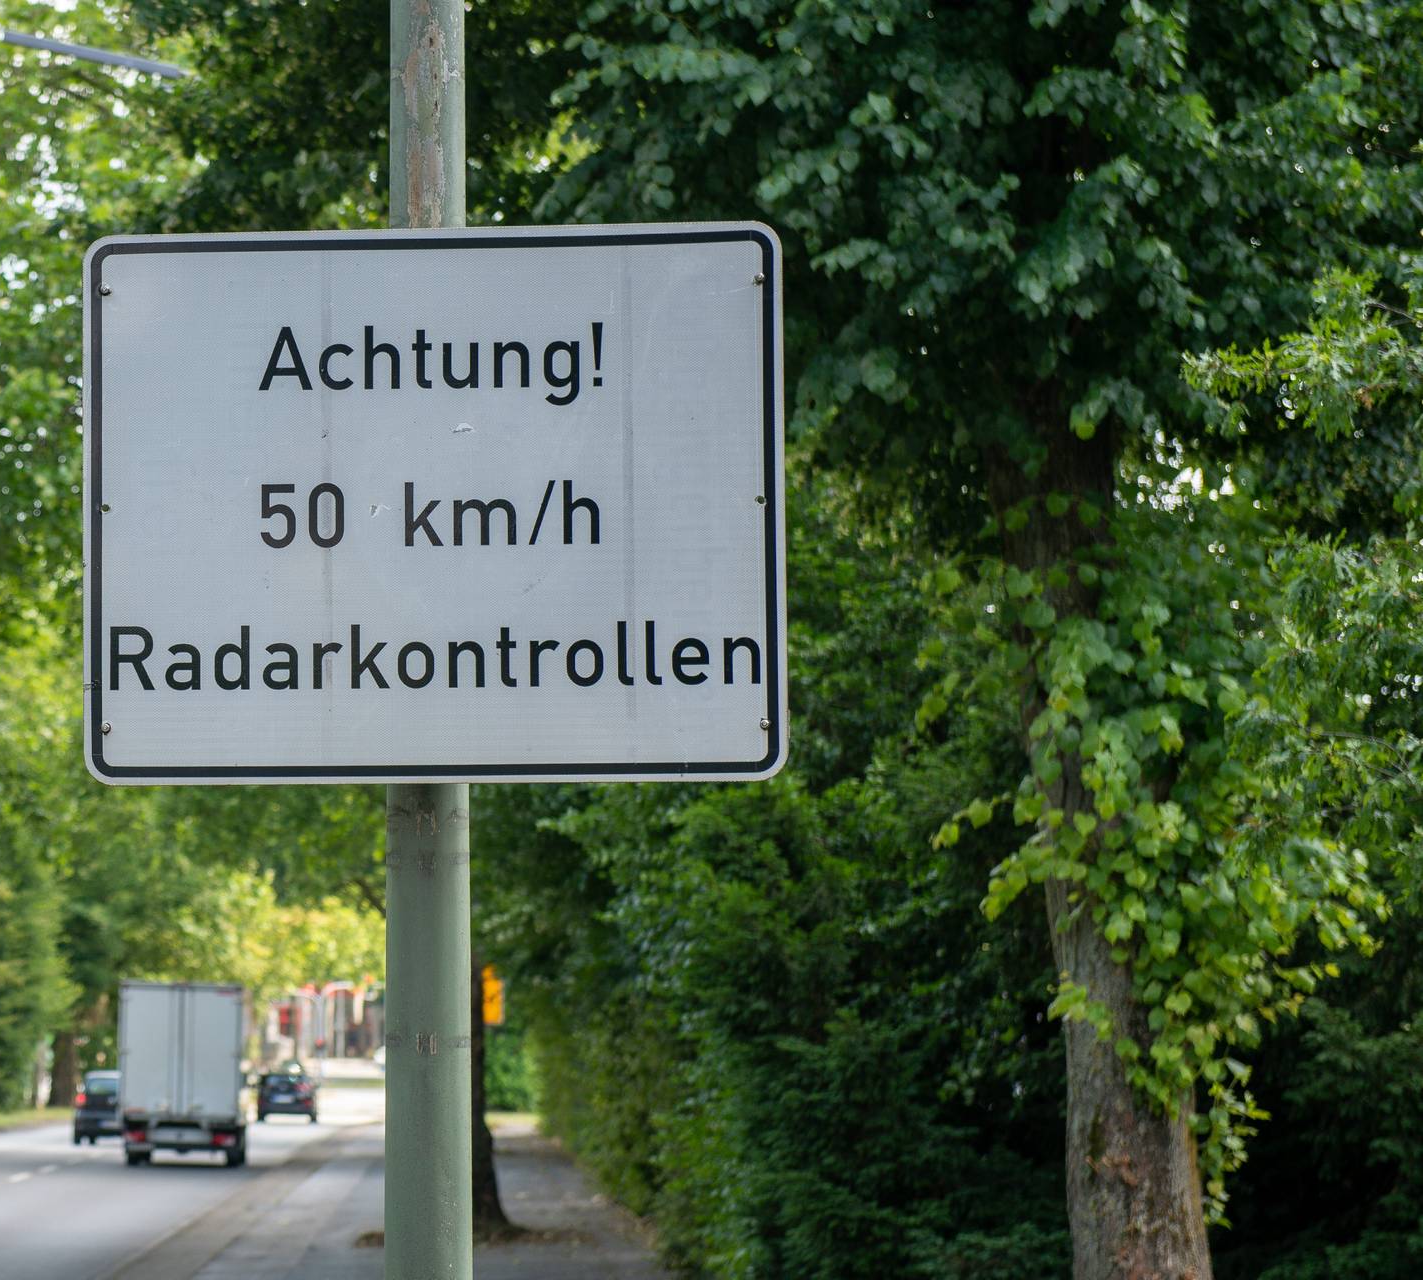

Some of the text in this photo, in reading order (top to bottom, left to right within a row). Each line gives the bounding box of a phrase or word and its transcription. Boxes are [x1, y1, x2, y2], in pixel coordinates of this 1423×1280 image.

[258, 321, 604, 406] Achtung!
[259, 479, 601, 549] 50 km/h
[109, 619, 761, 691] Radarkontrollen
